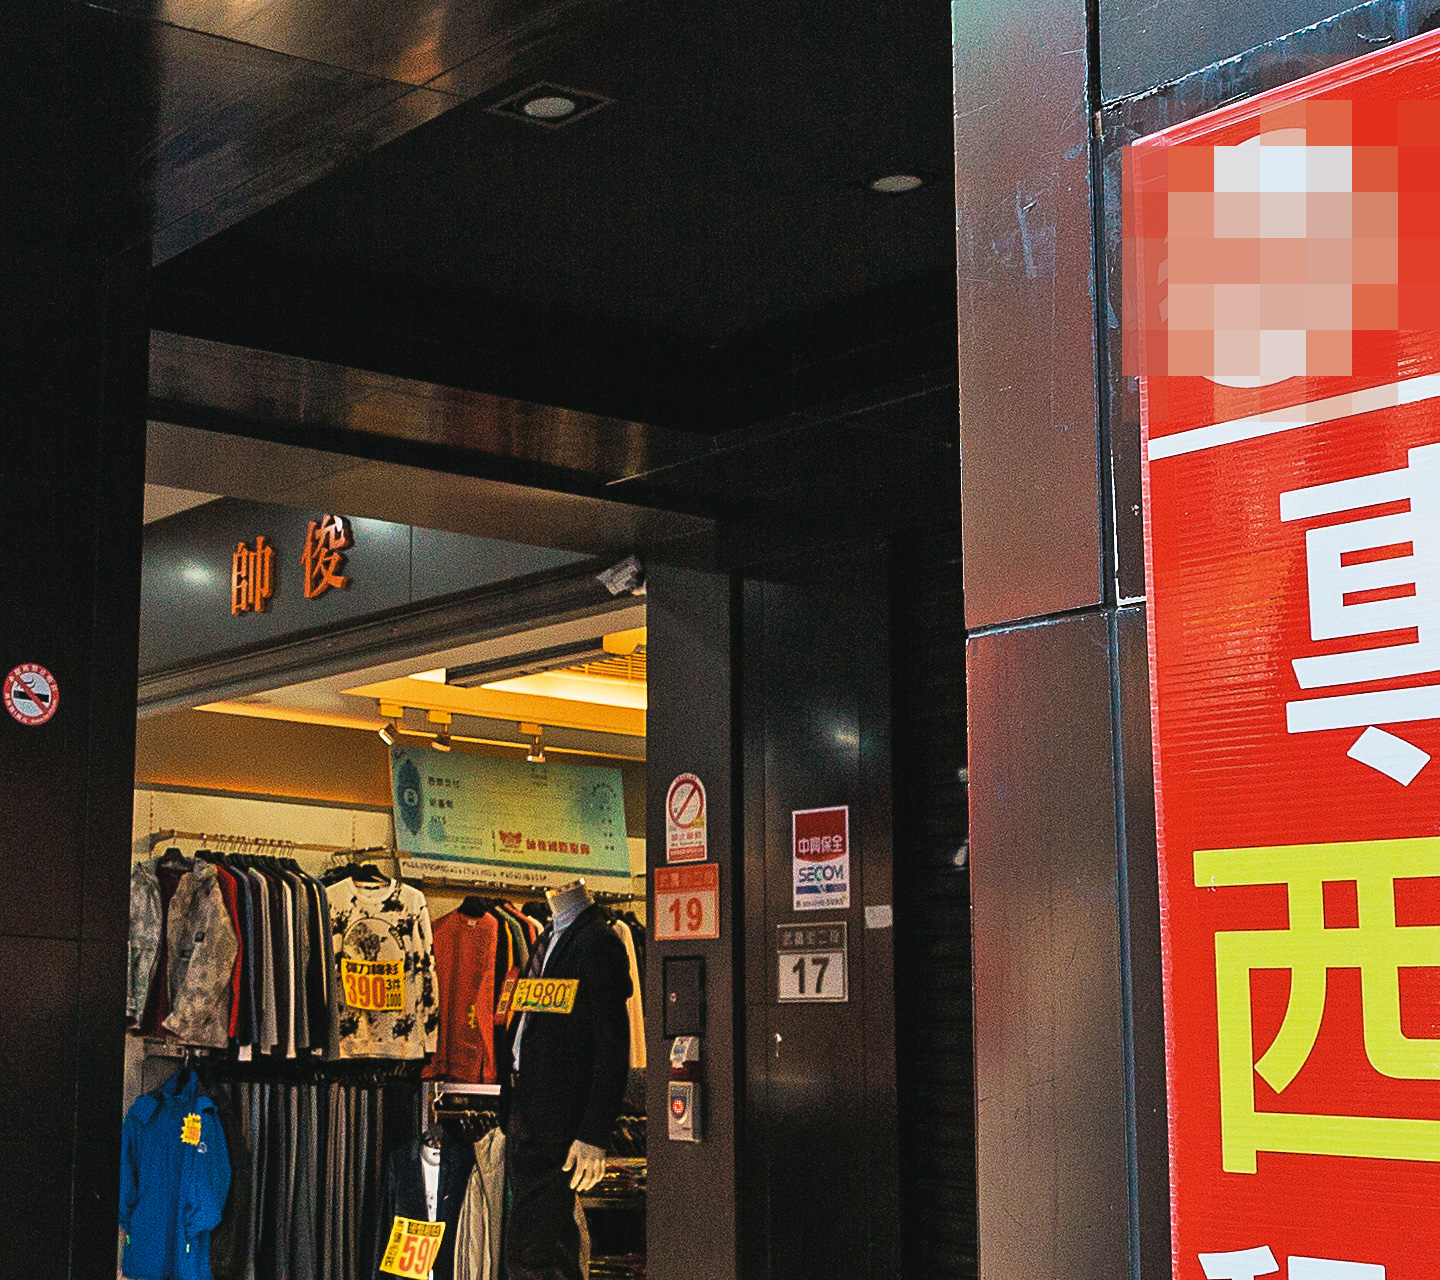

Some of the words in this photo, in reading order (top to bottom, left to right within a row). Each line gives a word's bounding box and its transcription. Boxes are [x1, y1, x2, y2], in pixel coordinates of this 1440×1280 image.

[230, 513, 354, 616] 帥俊
[798, 864, 844, 883] SECOM
[669, 897, 704, 932] 19
[345, 973, 386, 1009] 390
[792, 956, 830, 995] 17
[525, 981, 567, 1008] 1980
